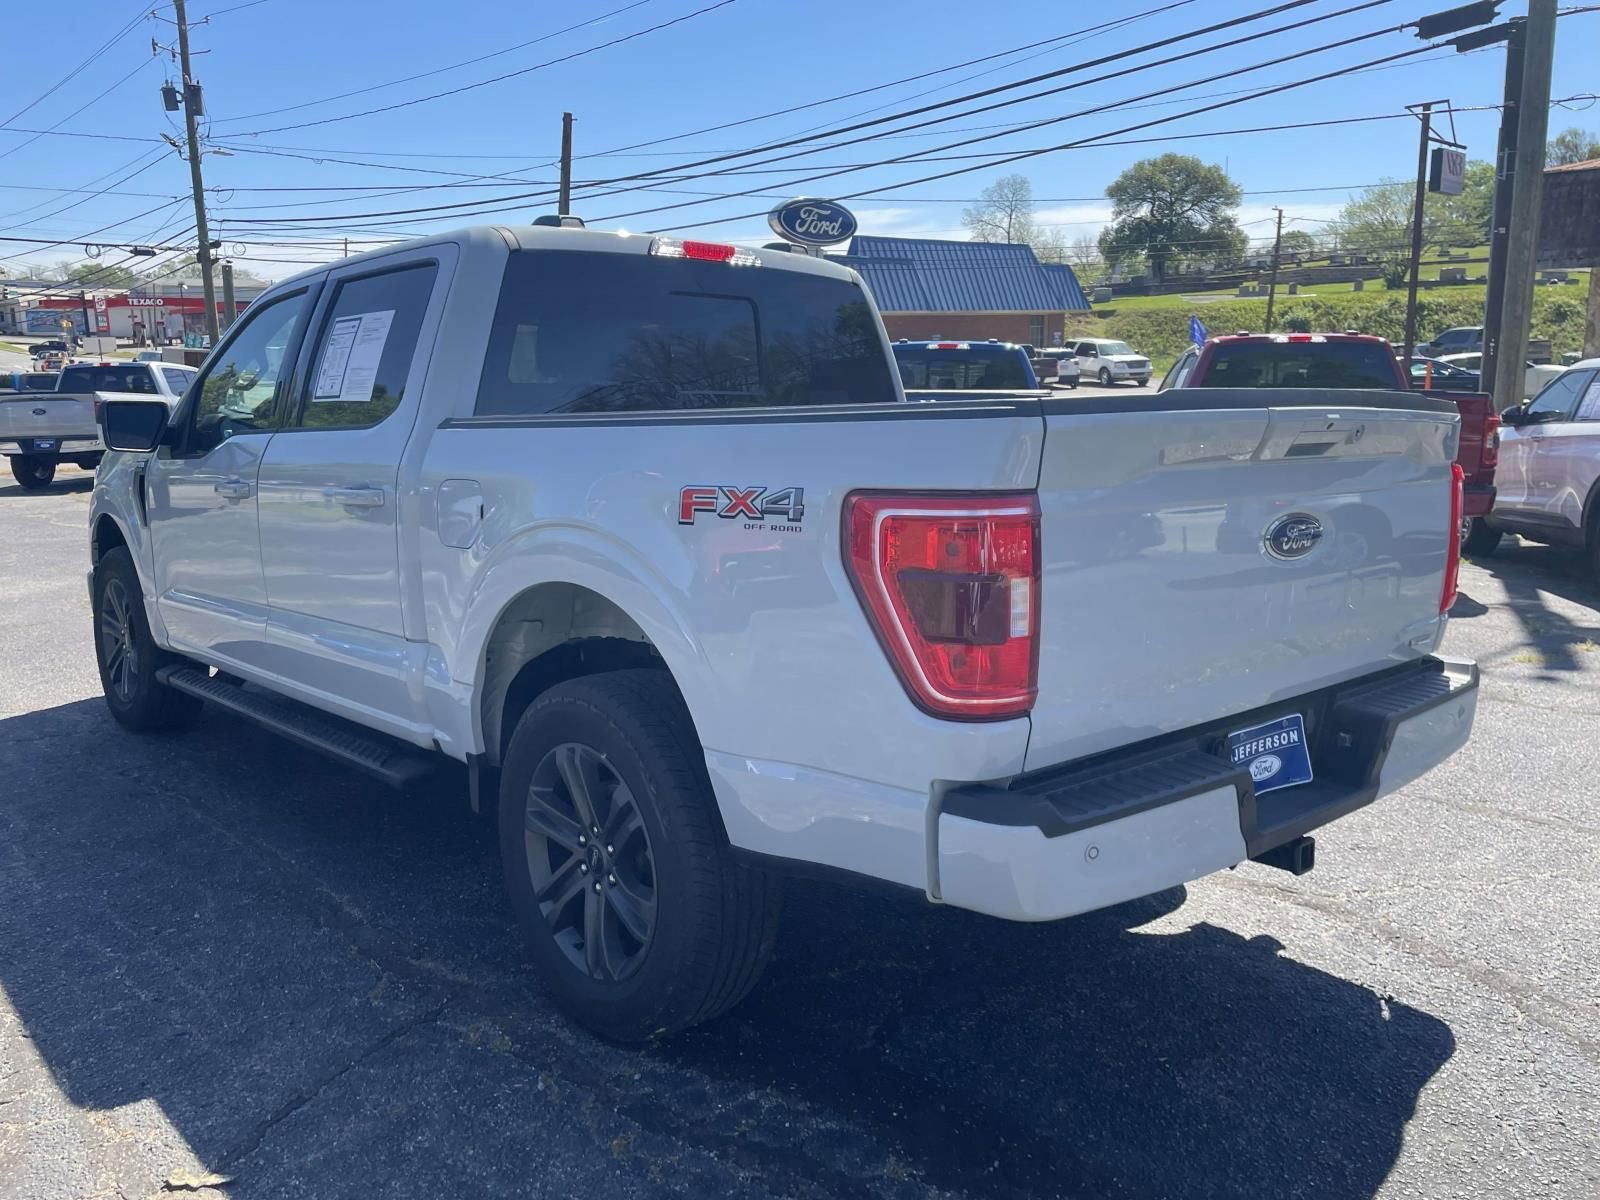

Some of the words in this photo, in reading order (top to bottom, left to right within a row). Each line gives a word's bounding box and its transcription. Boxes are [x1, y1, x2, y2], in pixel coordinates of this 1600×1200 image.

[795, 206, 842, 235] Ford
[128, 298, 163, 306] TEXACO
[678, 485, 804, 525] FX4
[744, 523, 766, 531] OFF
[770, 525, 802, 533] ROAD
[1280, 523, 1314, 550] Ford
[1234, 730, 1299, 762] JEFFERSON
[1253, 759, 1274, 778] Ford
